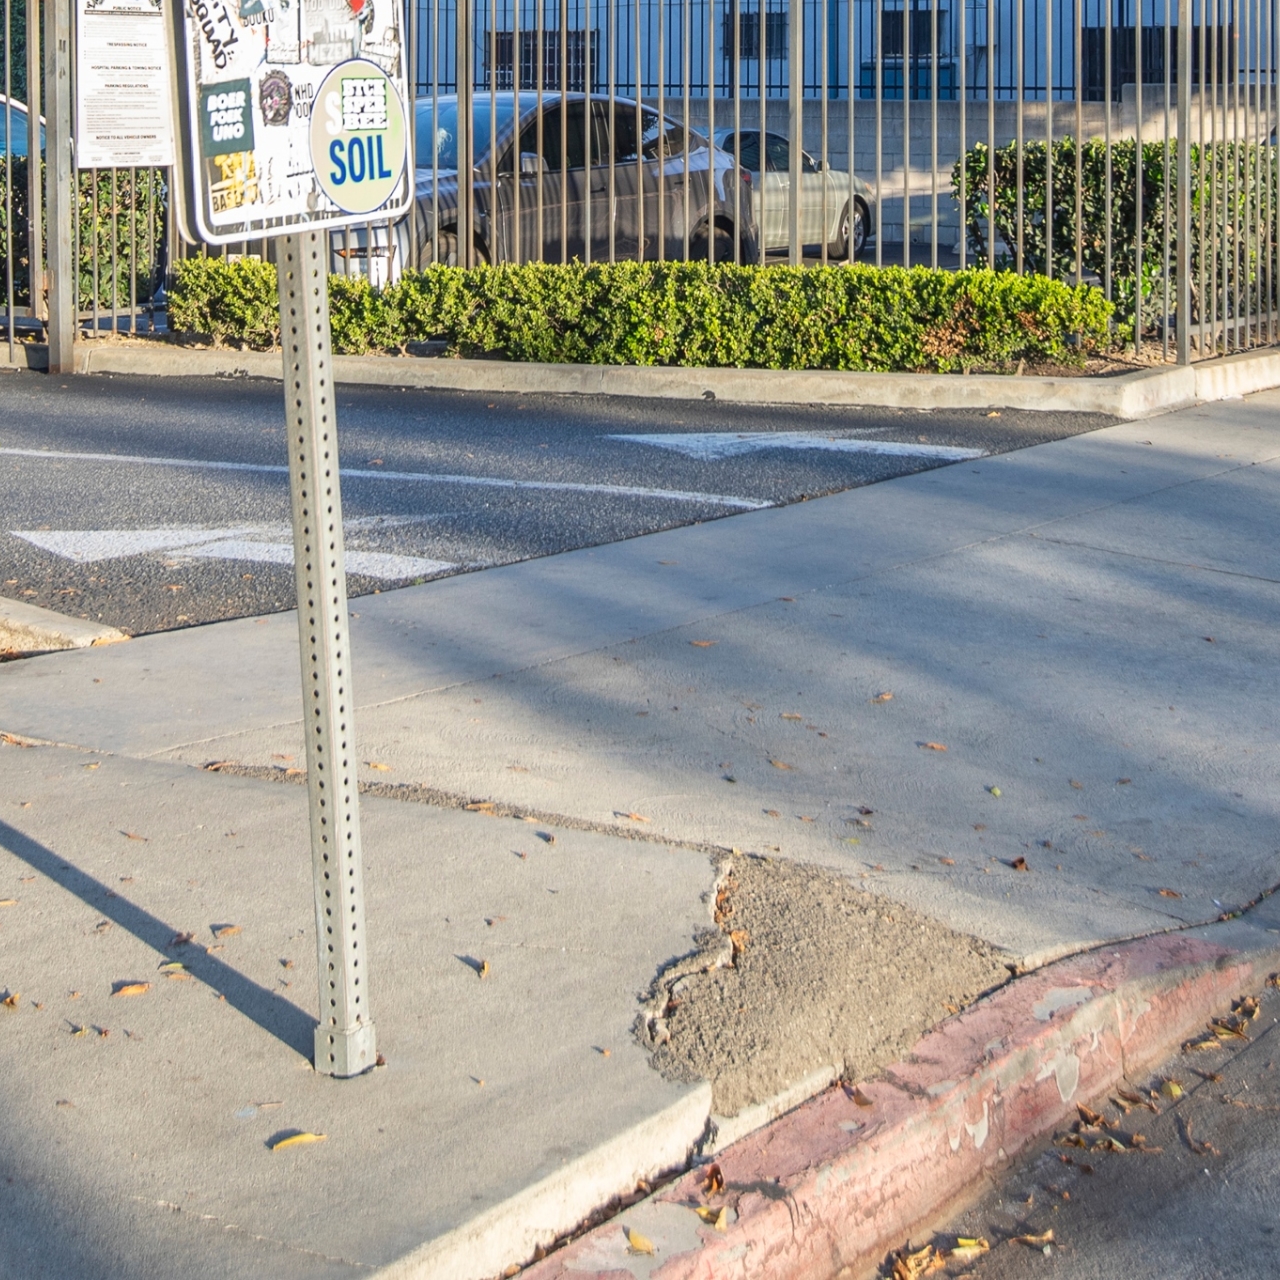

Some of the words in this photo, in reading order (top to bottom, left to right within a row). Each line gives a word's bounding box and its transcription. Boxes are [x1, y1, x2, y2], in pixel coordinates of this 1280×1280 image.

[206, 90, 247, 112] BOER
[212, 122, 246, 142] UNO
[329, 134, 392, 186] SOIL
